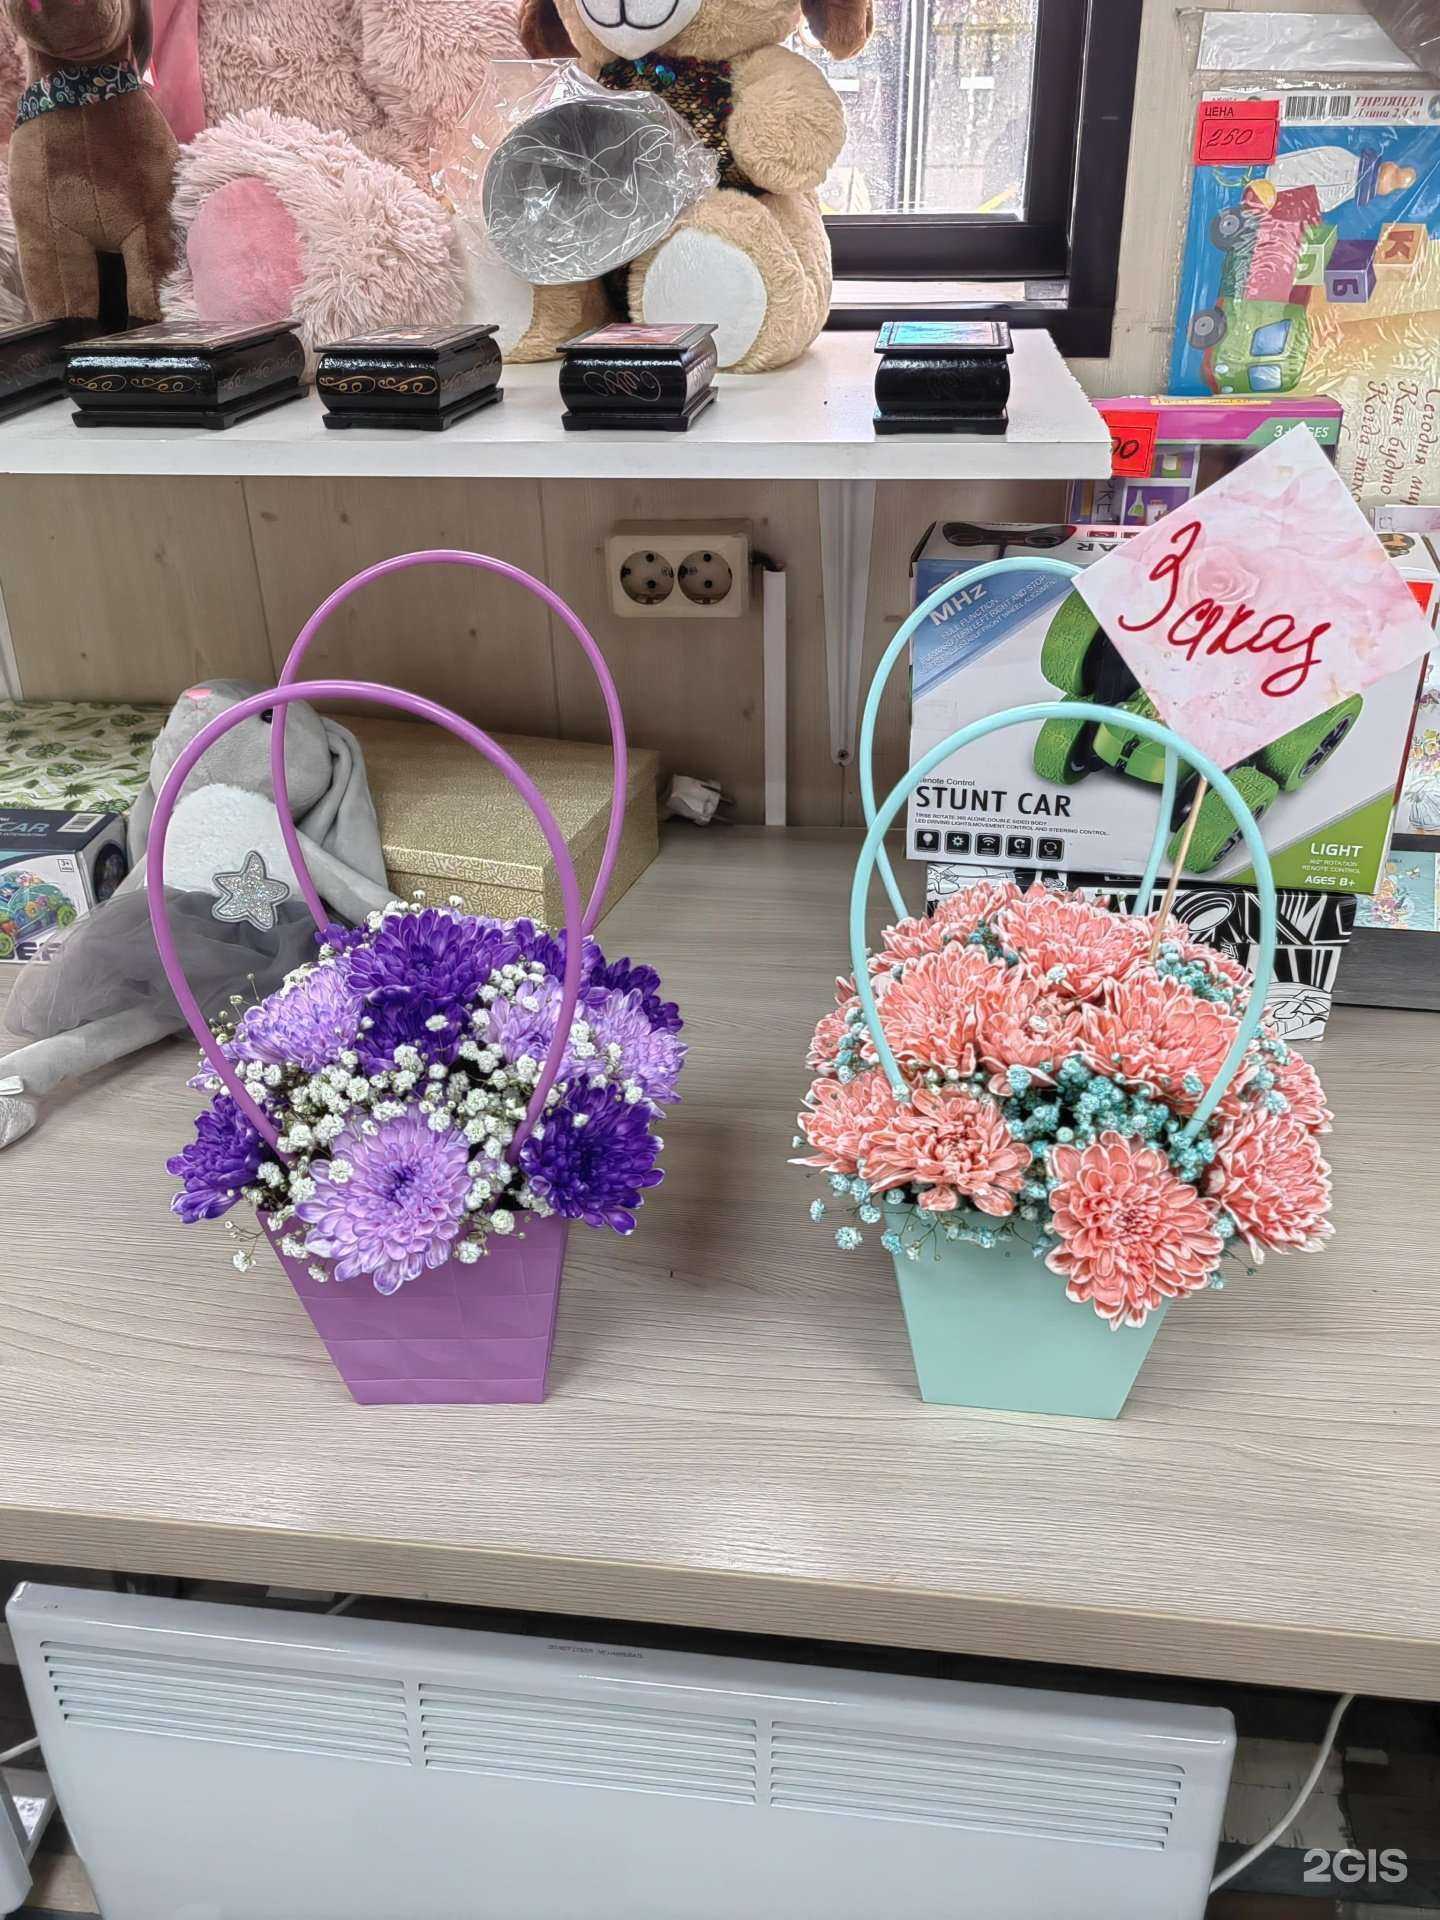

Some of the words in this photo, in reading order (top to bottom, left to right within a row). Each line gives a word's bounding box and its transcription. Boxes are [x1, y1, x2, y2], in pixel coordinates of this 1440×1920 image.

[1204, 106, 1234, 118] ЦЕНА
[1206, 127, 1253, 148] 250
[1359, 380, 1389, 445] Когда
[1351, 455, 1369, 504] тако
[1378, 436, 1409, 496] будто
[928, 583, 988, 626] MHz
[1118, 521, 1333, 698] Заказ
[920, 777, 945, 785] emote
[946, 778, 975, 787] Control
[915, 785, 1008, 812] STUNT
[1017, 792, 1072, 817] CAR
[1310, 842, 1363, 858] LIGHT
[1304, 874, 1336, 886] AGES
